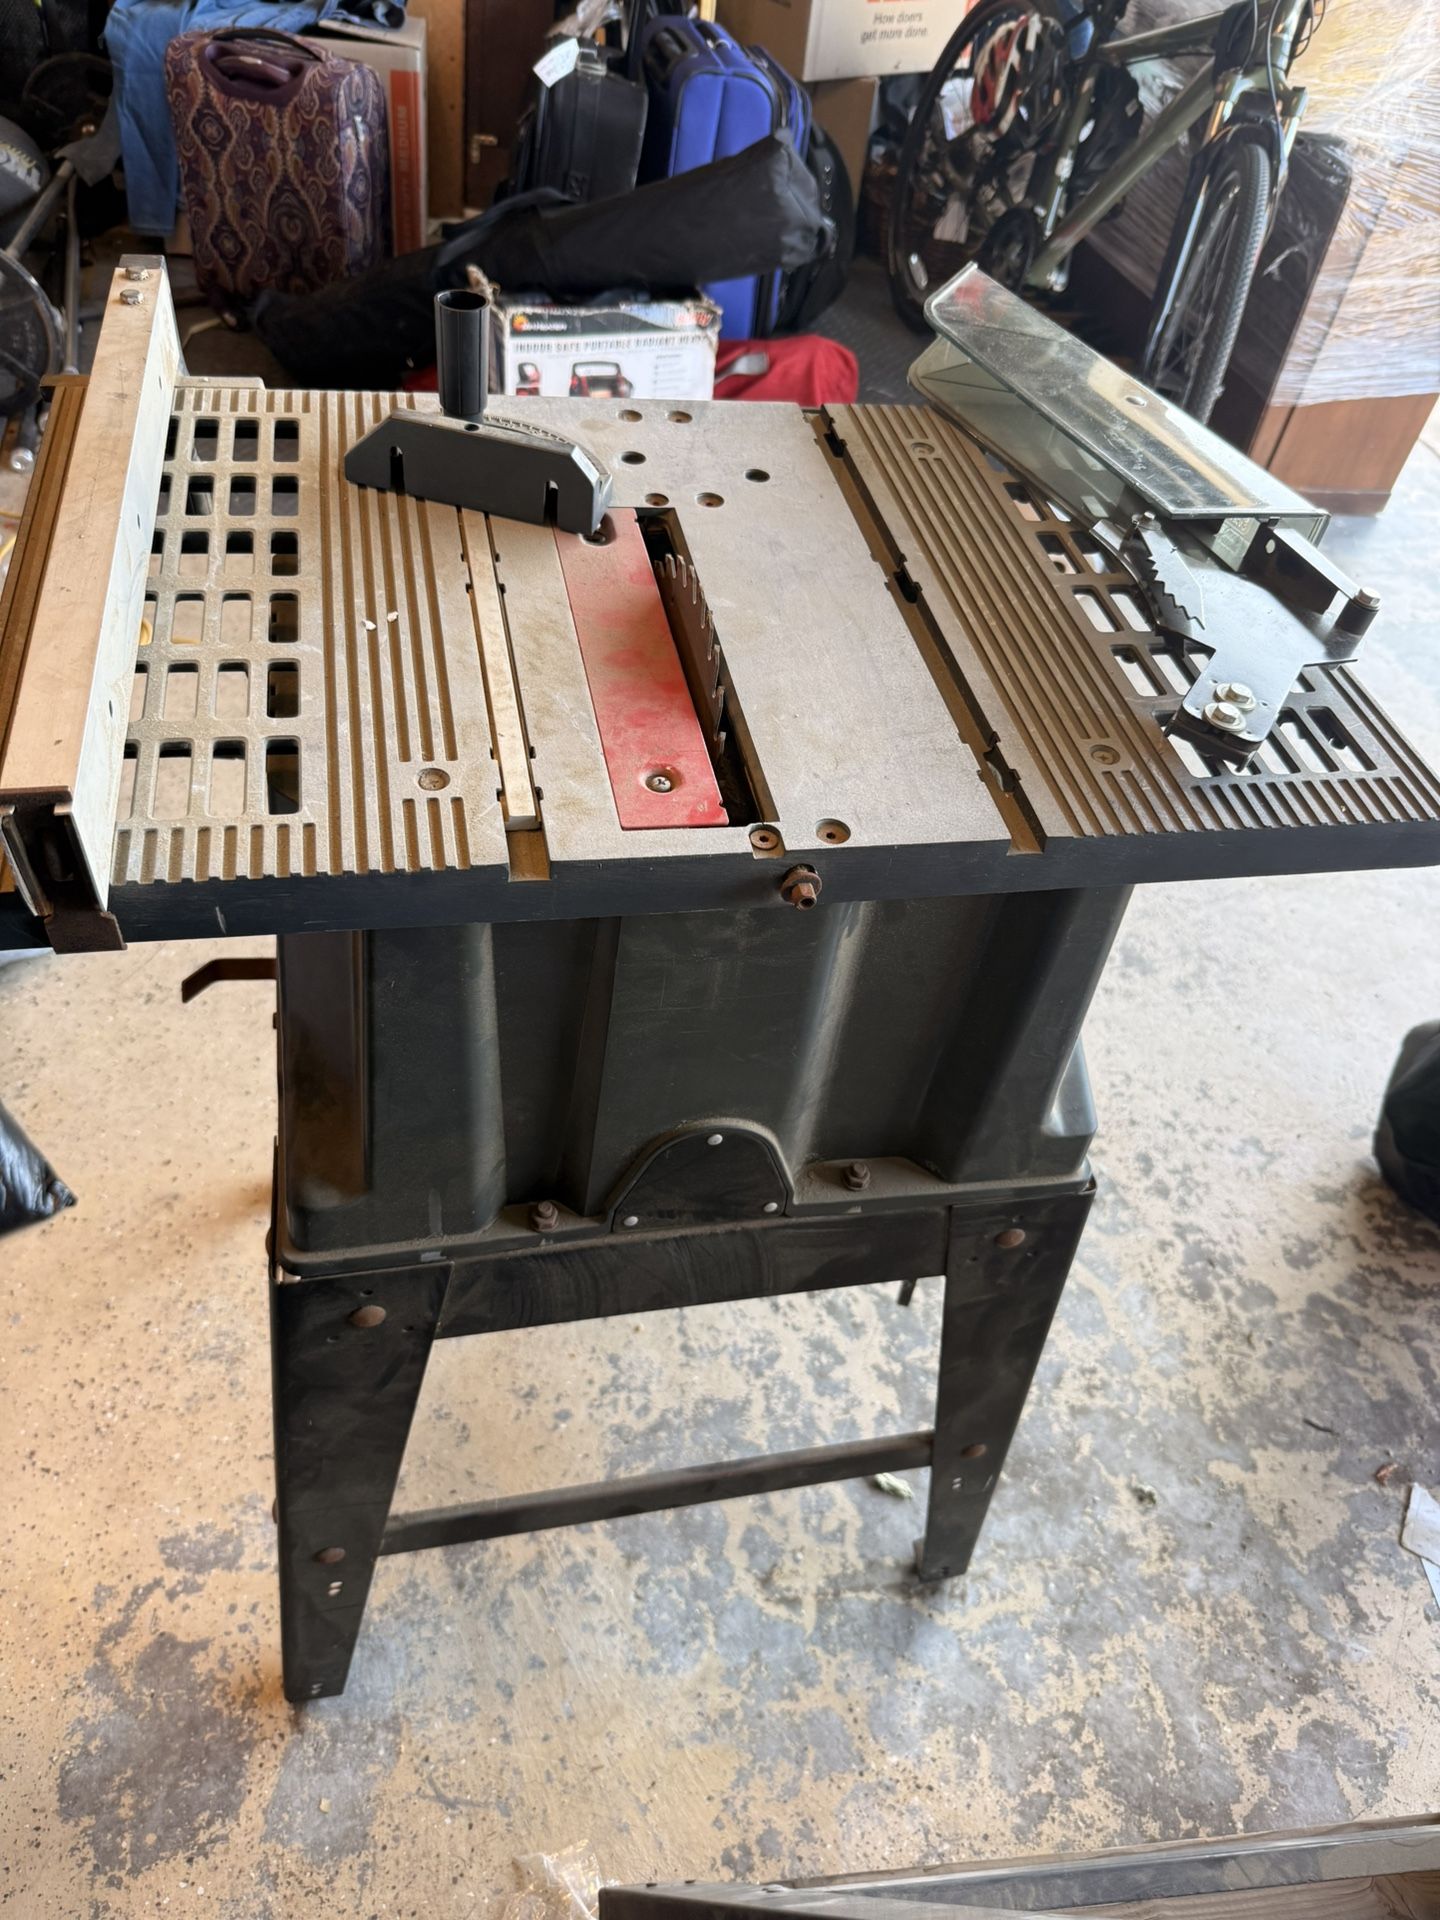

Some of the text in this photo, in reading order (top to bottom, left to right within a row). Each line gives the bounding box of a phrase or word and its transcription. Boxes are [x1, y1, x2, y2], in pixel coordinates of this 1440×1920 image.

[873, 11, 922, 24] How doers
[861, 29, 877, 45] get
[879, 29, 903, 40] more
